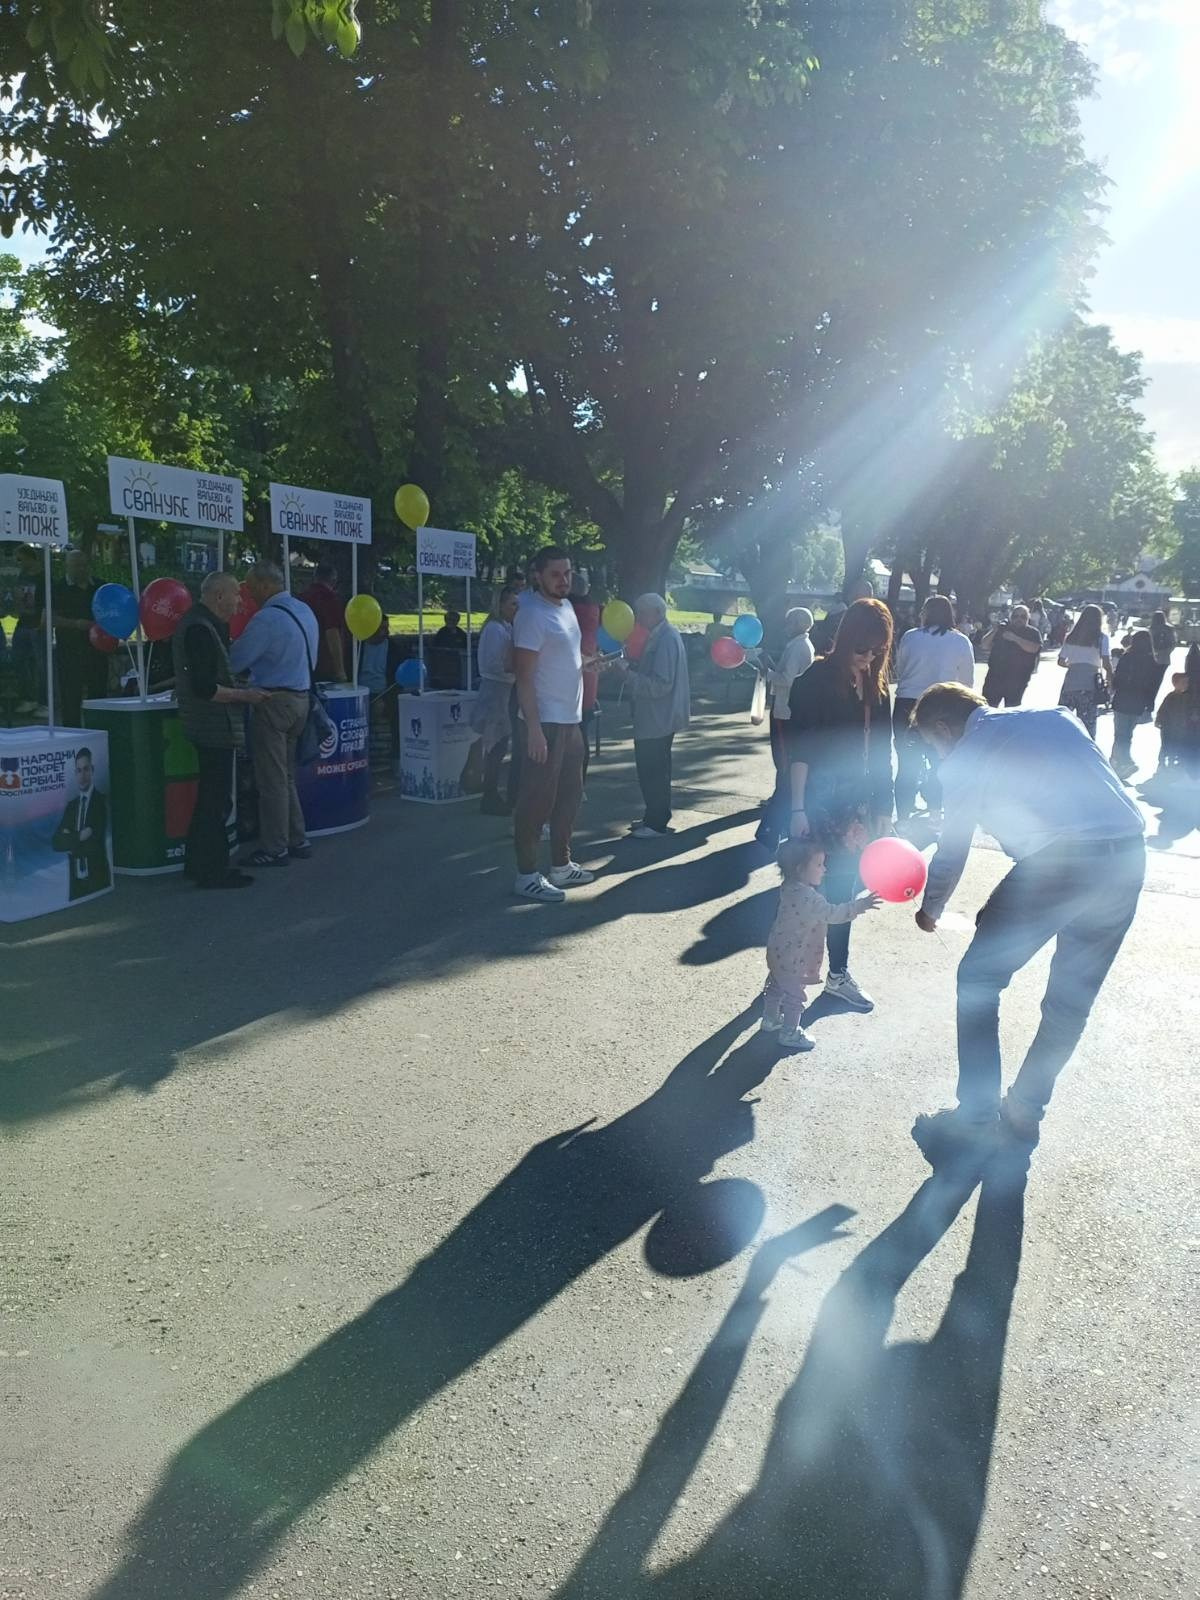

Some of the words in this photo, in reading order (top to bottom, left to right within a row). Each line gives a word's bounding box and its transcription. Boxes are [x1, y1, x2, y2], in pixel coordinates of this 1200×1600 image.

[123, 487, 190, 518] СВАНУЋЕ
[197, 501, 234, 524] МОЖЕ
[18, 514, 61, 537] МОЖЕ
[279, 510, 328, 534] СВАНУЋЕ
[334, 519, 364, 538] МОЖЕ
[20, 748, 76, 766] НАРОДНИ
[21, 761, 66, 777] ПОКРЕТ
[22, 772, 65, 788] СРБИЈЕ
